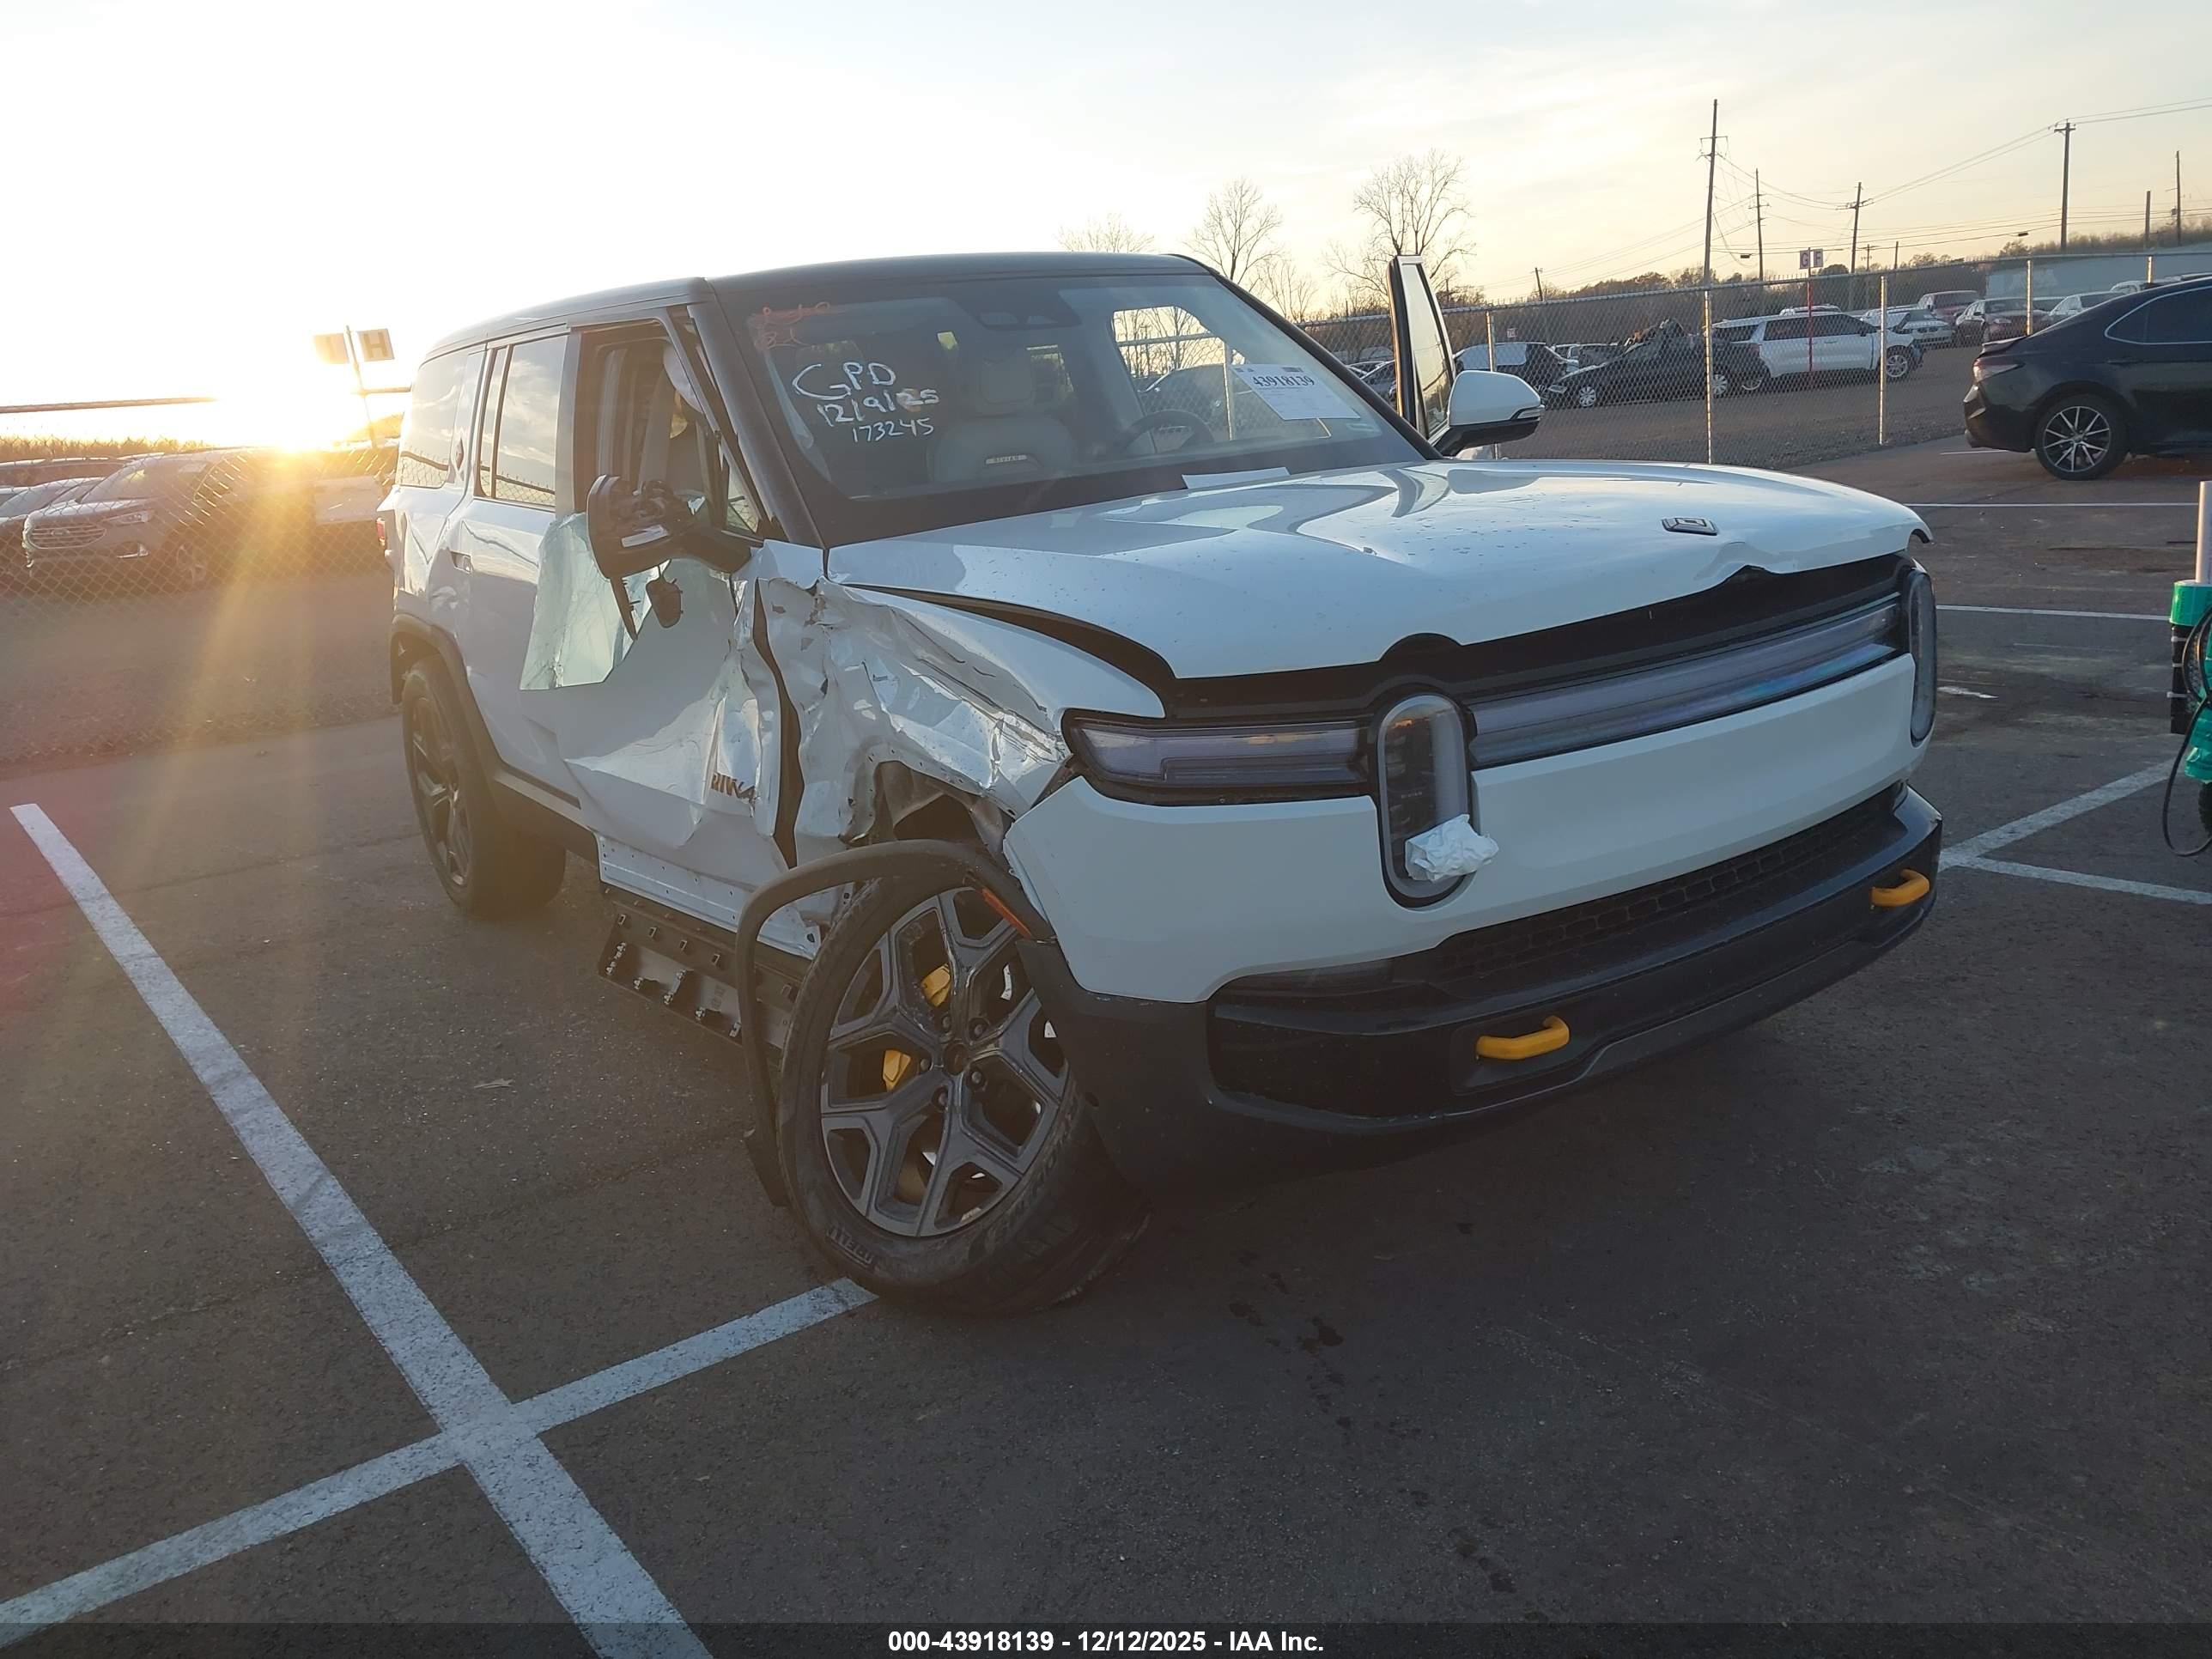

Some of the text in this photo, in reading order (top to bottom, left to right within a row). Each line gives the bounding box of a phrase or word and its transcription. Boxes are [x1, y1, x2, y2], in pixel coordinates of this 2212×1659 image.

[1801, 252, 1808, 267] G
[363, 331, 388, 358] H
[792, 361, 896, 400] GPD
[1253, 374, 1316, 387] 43918139
[852, 417, 934, 442] 173245
